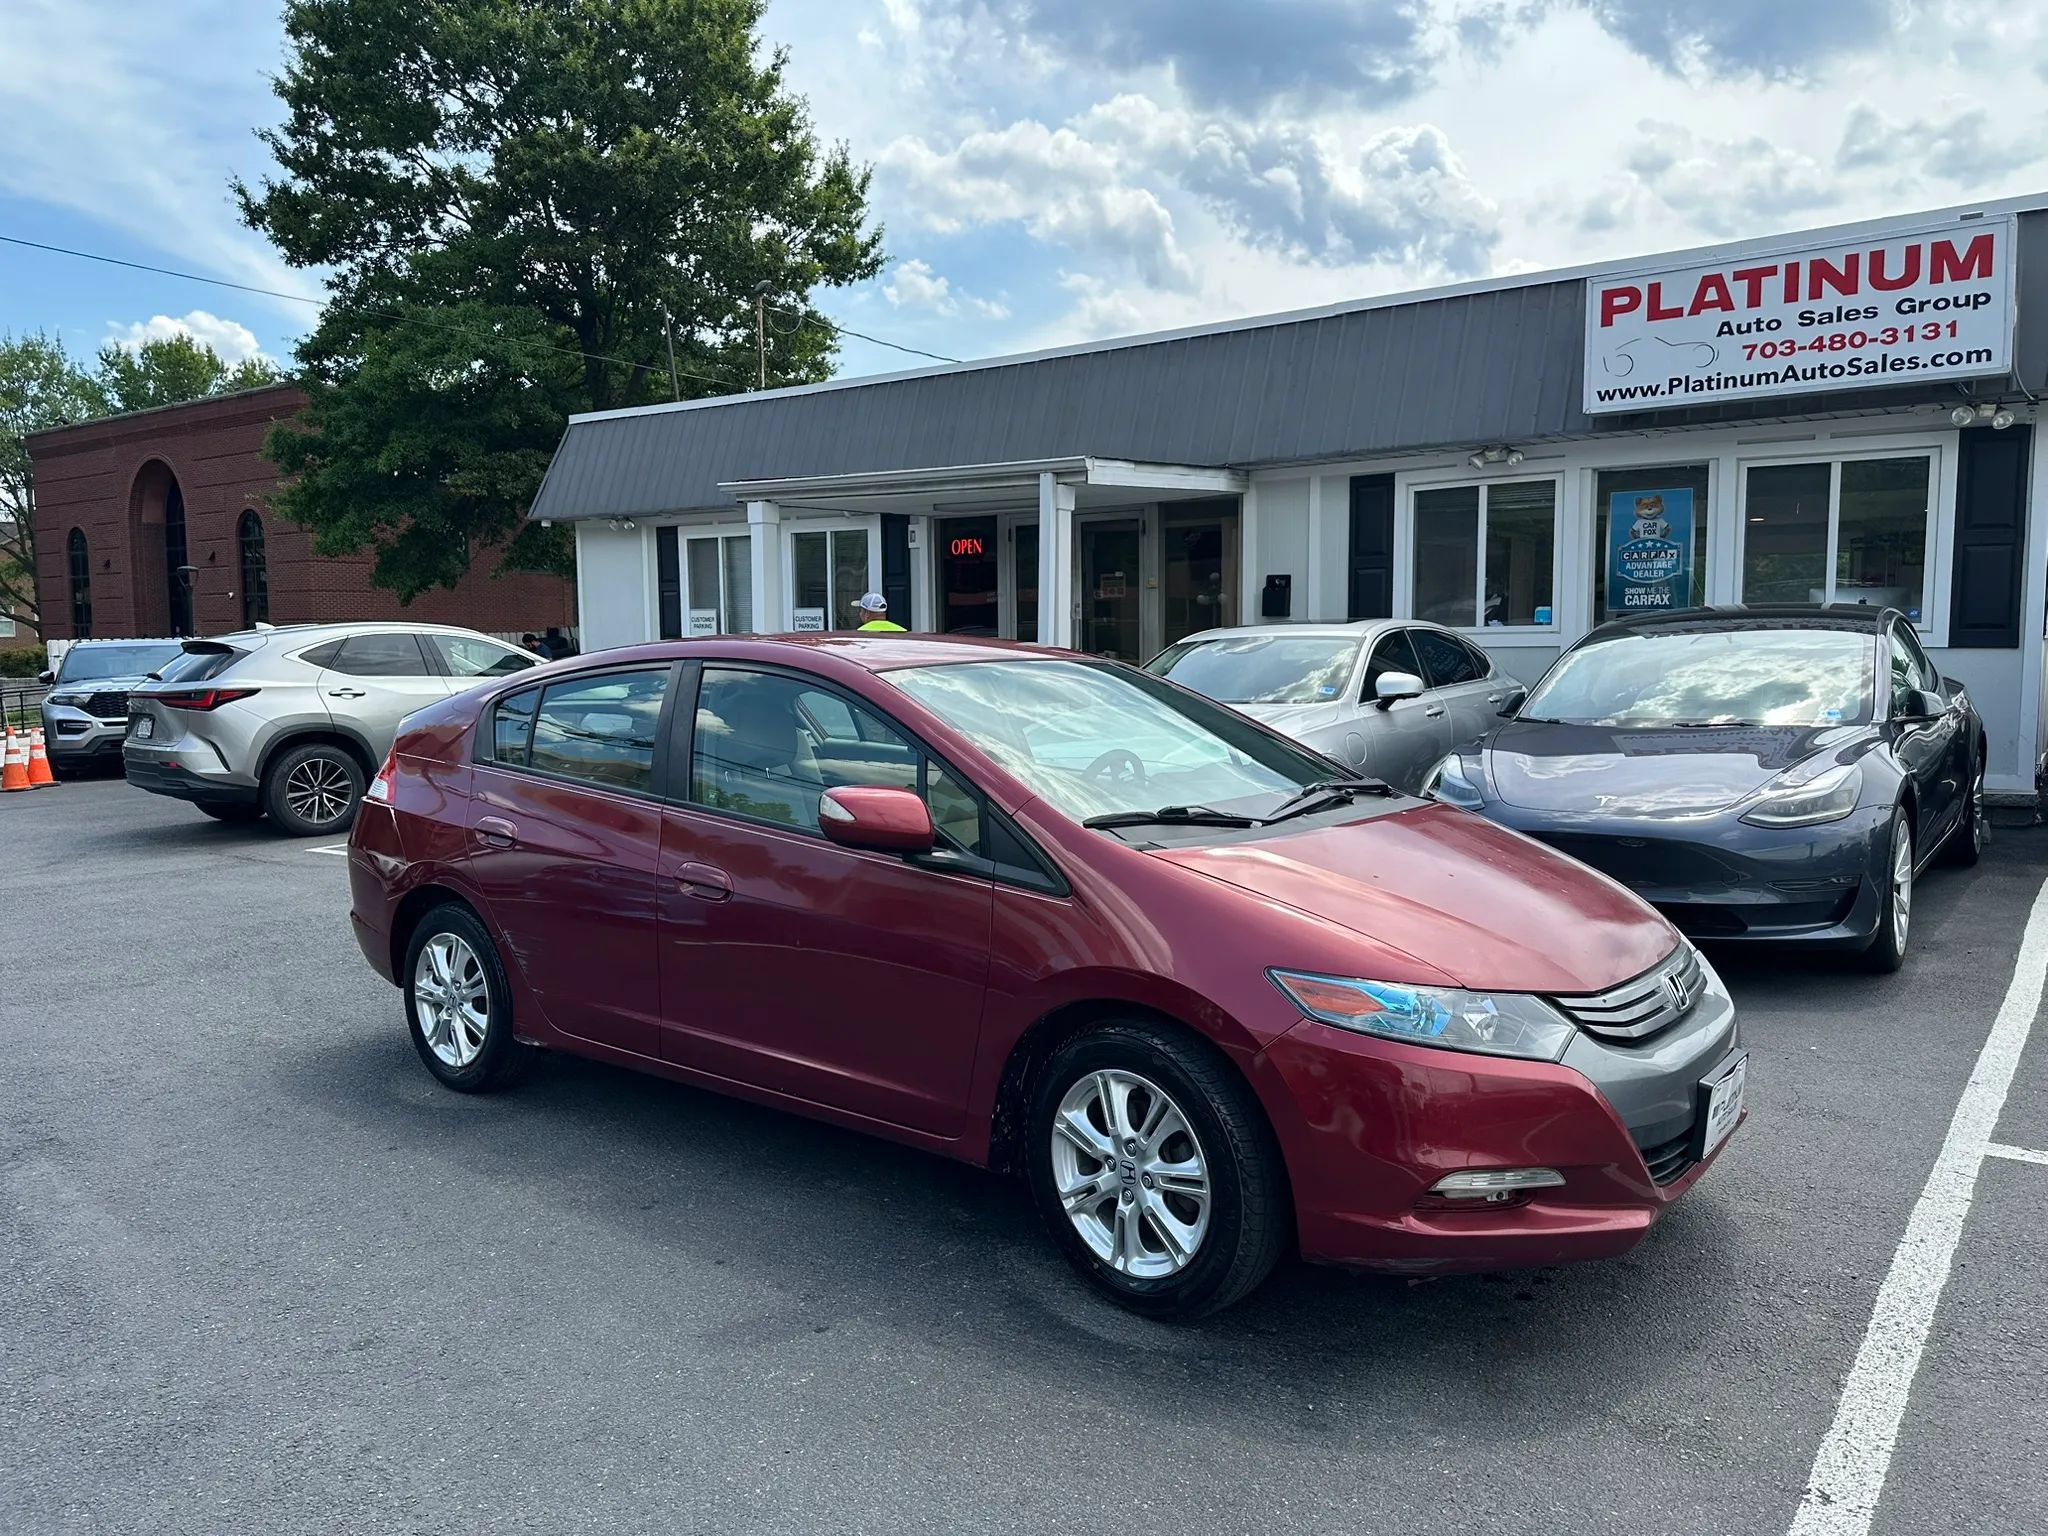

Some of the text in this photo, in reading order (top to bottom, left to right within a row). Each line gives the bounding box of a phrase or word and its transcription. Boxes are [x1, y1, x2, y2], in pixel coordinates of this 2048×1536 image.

[1600, 234, 1994, 328] PLATINUM
[1716, 292, 1992, 338] Auto Sales Group
[1742, 320, 1957, 361] 703-480-3131
[1596, 348, 1992, 402] www.PlatinumAutoSales.com
[1642, 528, 1657, 536] FOX
[951, 538, 982, 555] OPEN
[1623, 550, 1676, 560] CARFAX
[1633, 569, 1665, 578] DEALER
[1646, 586, 1657, 594] ME
[1658, 586, 1671, 594] THE
[1624, 594, 1671, 606] CARFAX
